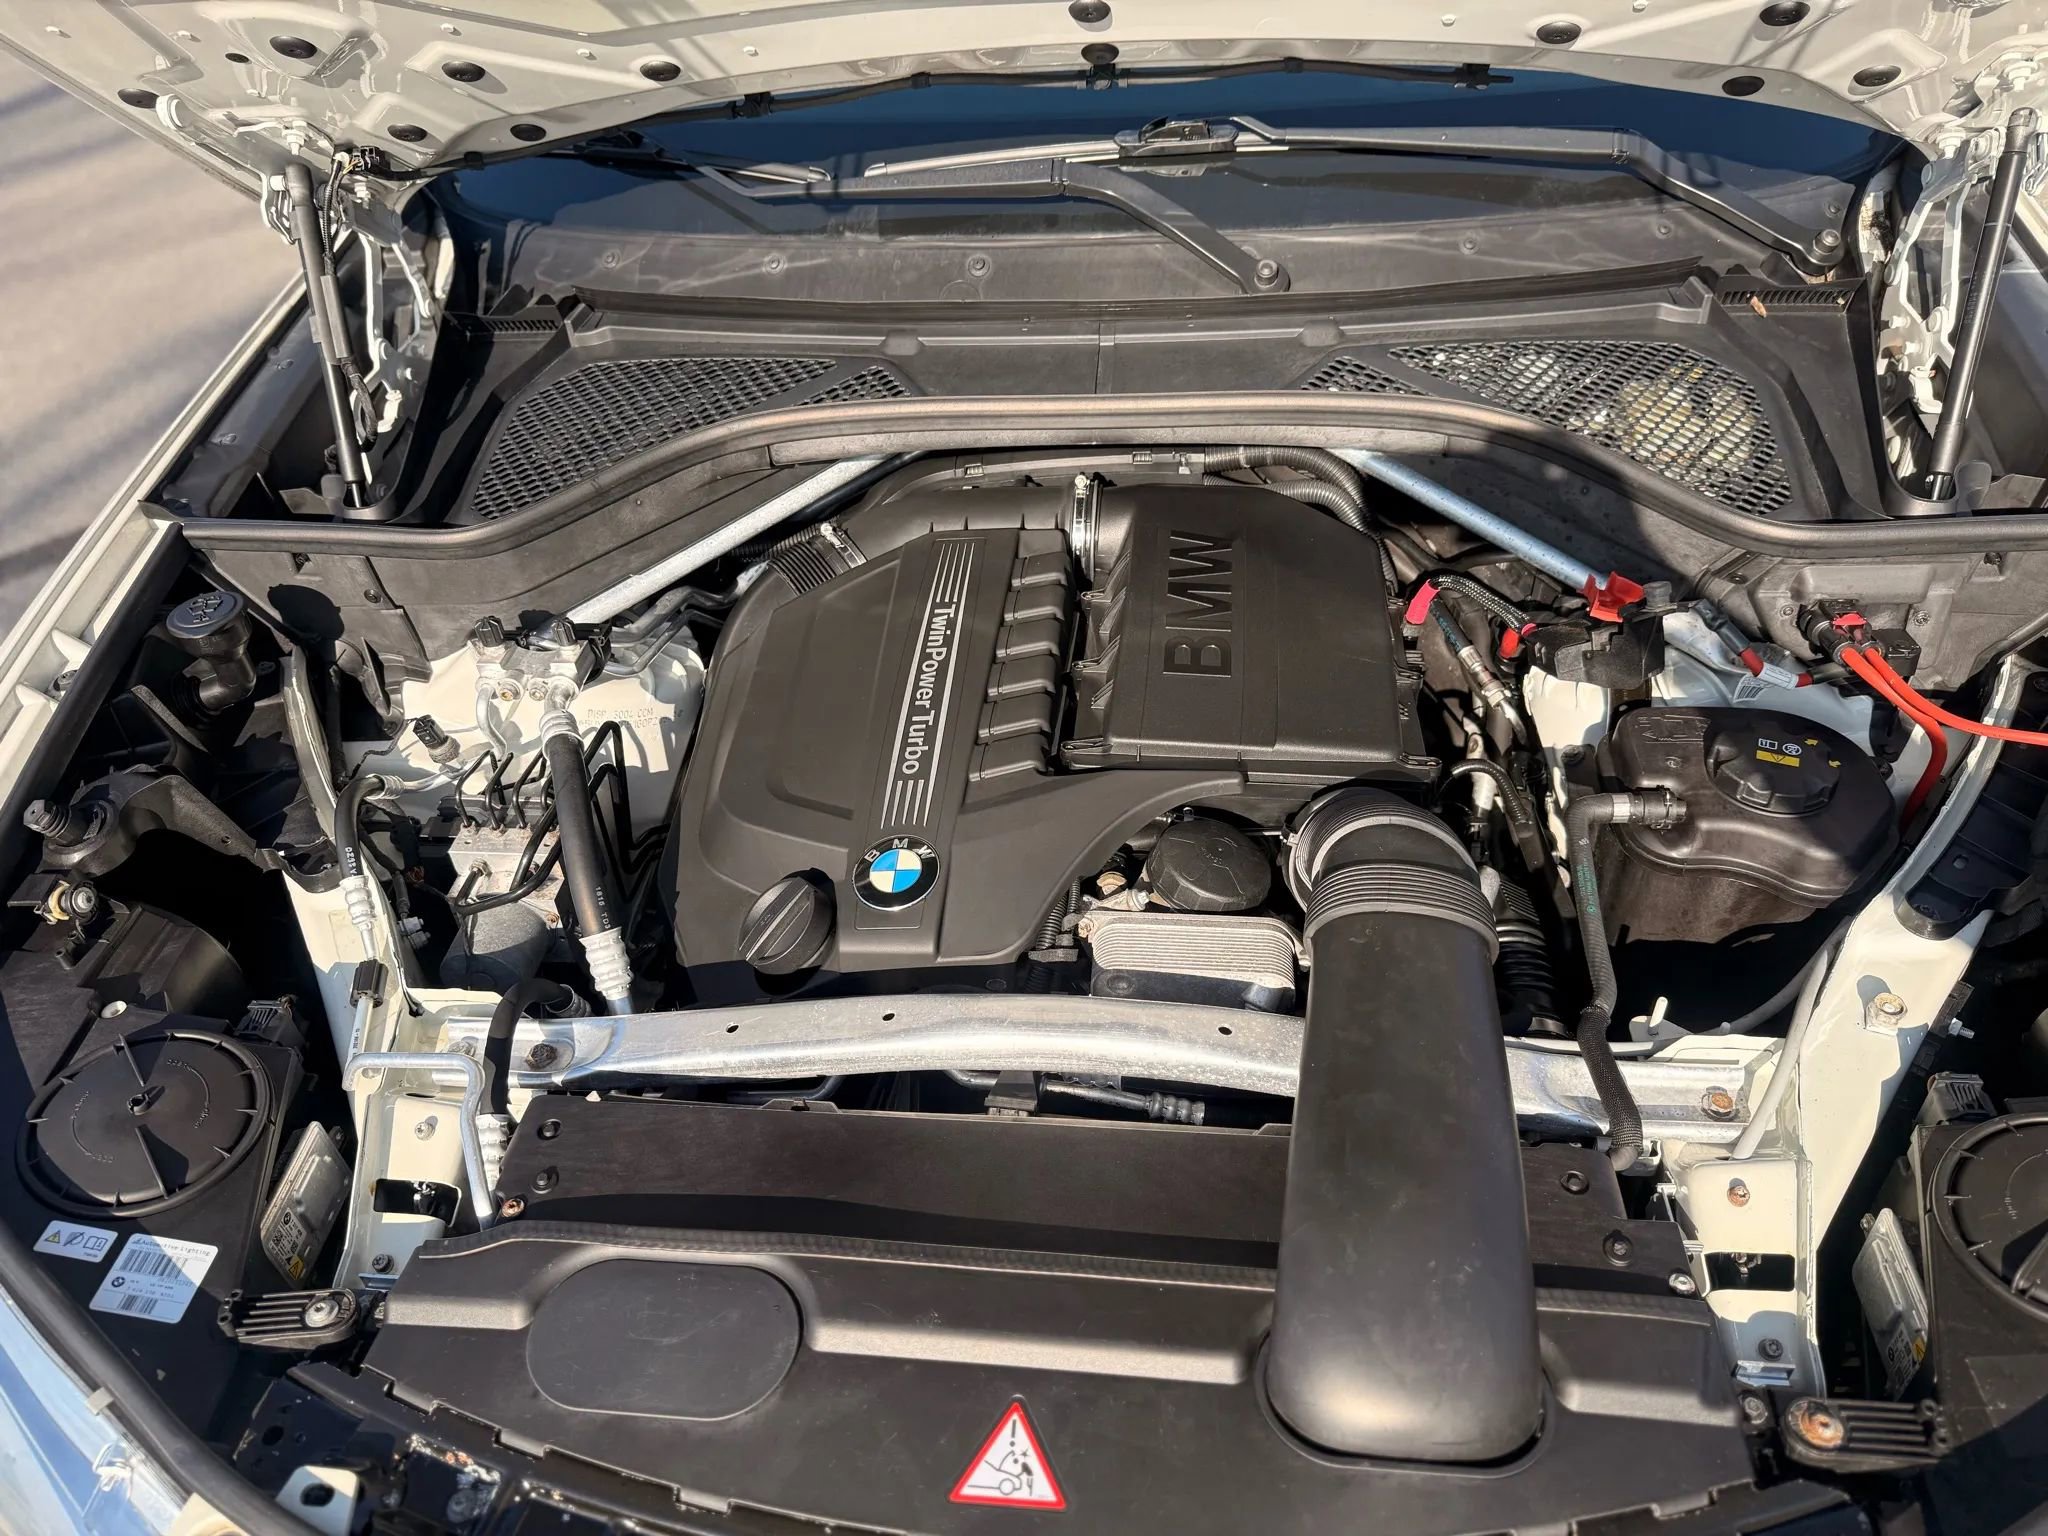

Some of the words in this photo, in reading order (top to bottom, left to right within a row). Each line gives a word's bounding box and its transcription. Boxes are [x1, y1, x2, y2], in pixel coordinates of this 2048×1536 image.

[1163, 529, 1233, 678] BMW
[914, 603, 956, 708] TwinPower
[902, 709, 935, 775] Turbo
[863, 837, 935, 862] BMW
